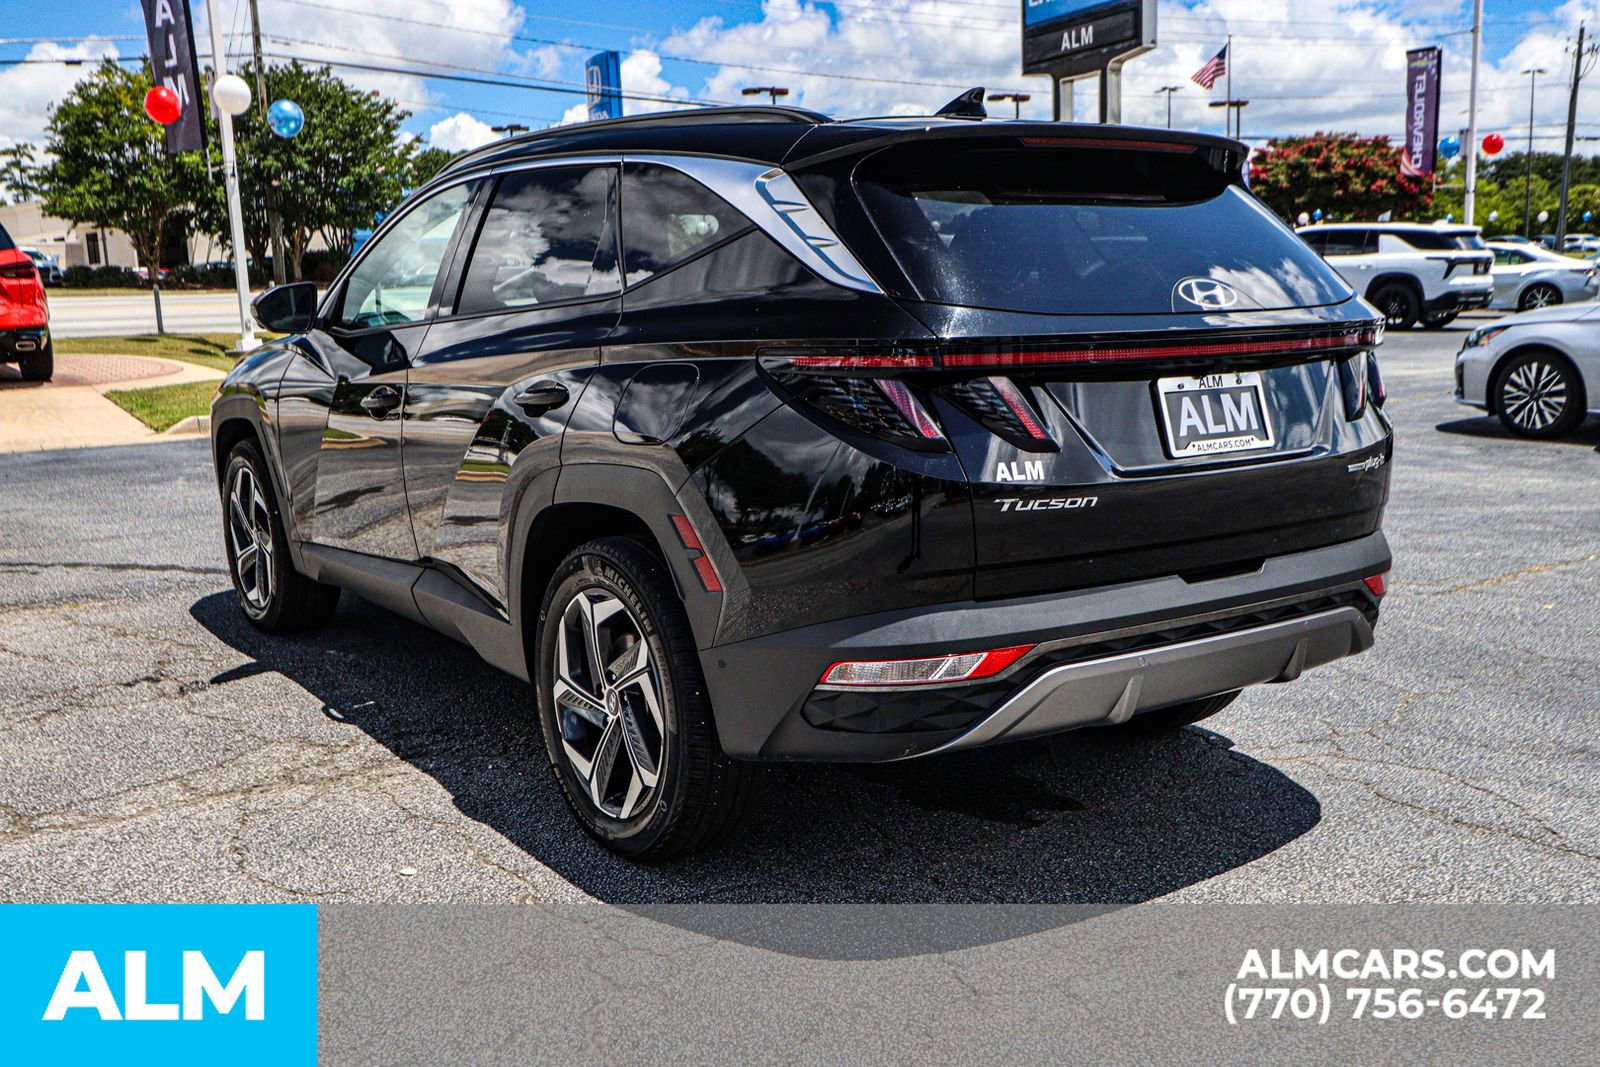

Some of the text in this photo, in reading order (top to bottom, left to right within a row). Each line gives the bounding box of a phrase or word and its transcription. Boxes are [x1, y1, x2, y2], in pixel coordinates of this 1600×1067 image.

[1061, 25, 1093, 51] ALM
[1199, 375, 1224, 389] ALM
[1179, 392, 1259, 437] ALM
[1197, 438, 1251, 452] ALMCARS.COM
[996, 460, 1045, 482] ALM
[604, 566, 654, 633] MICHELIN
